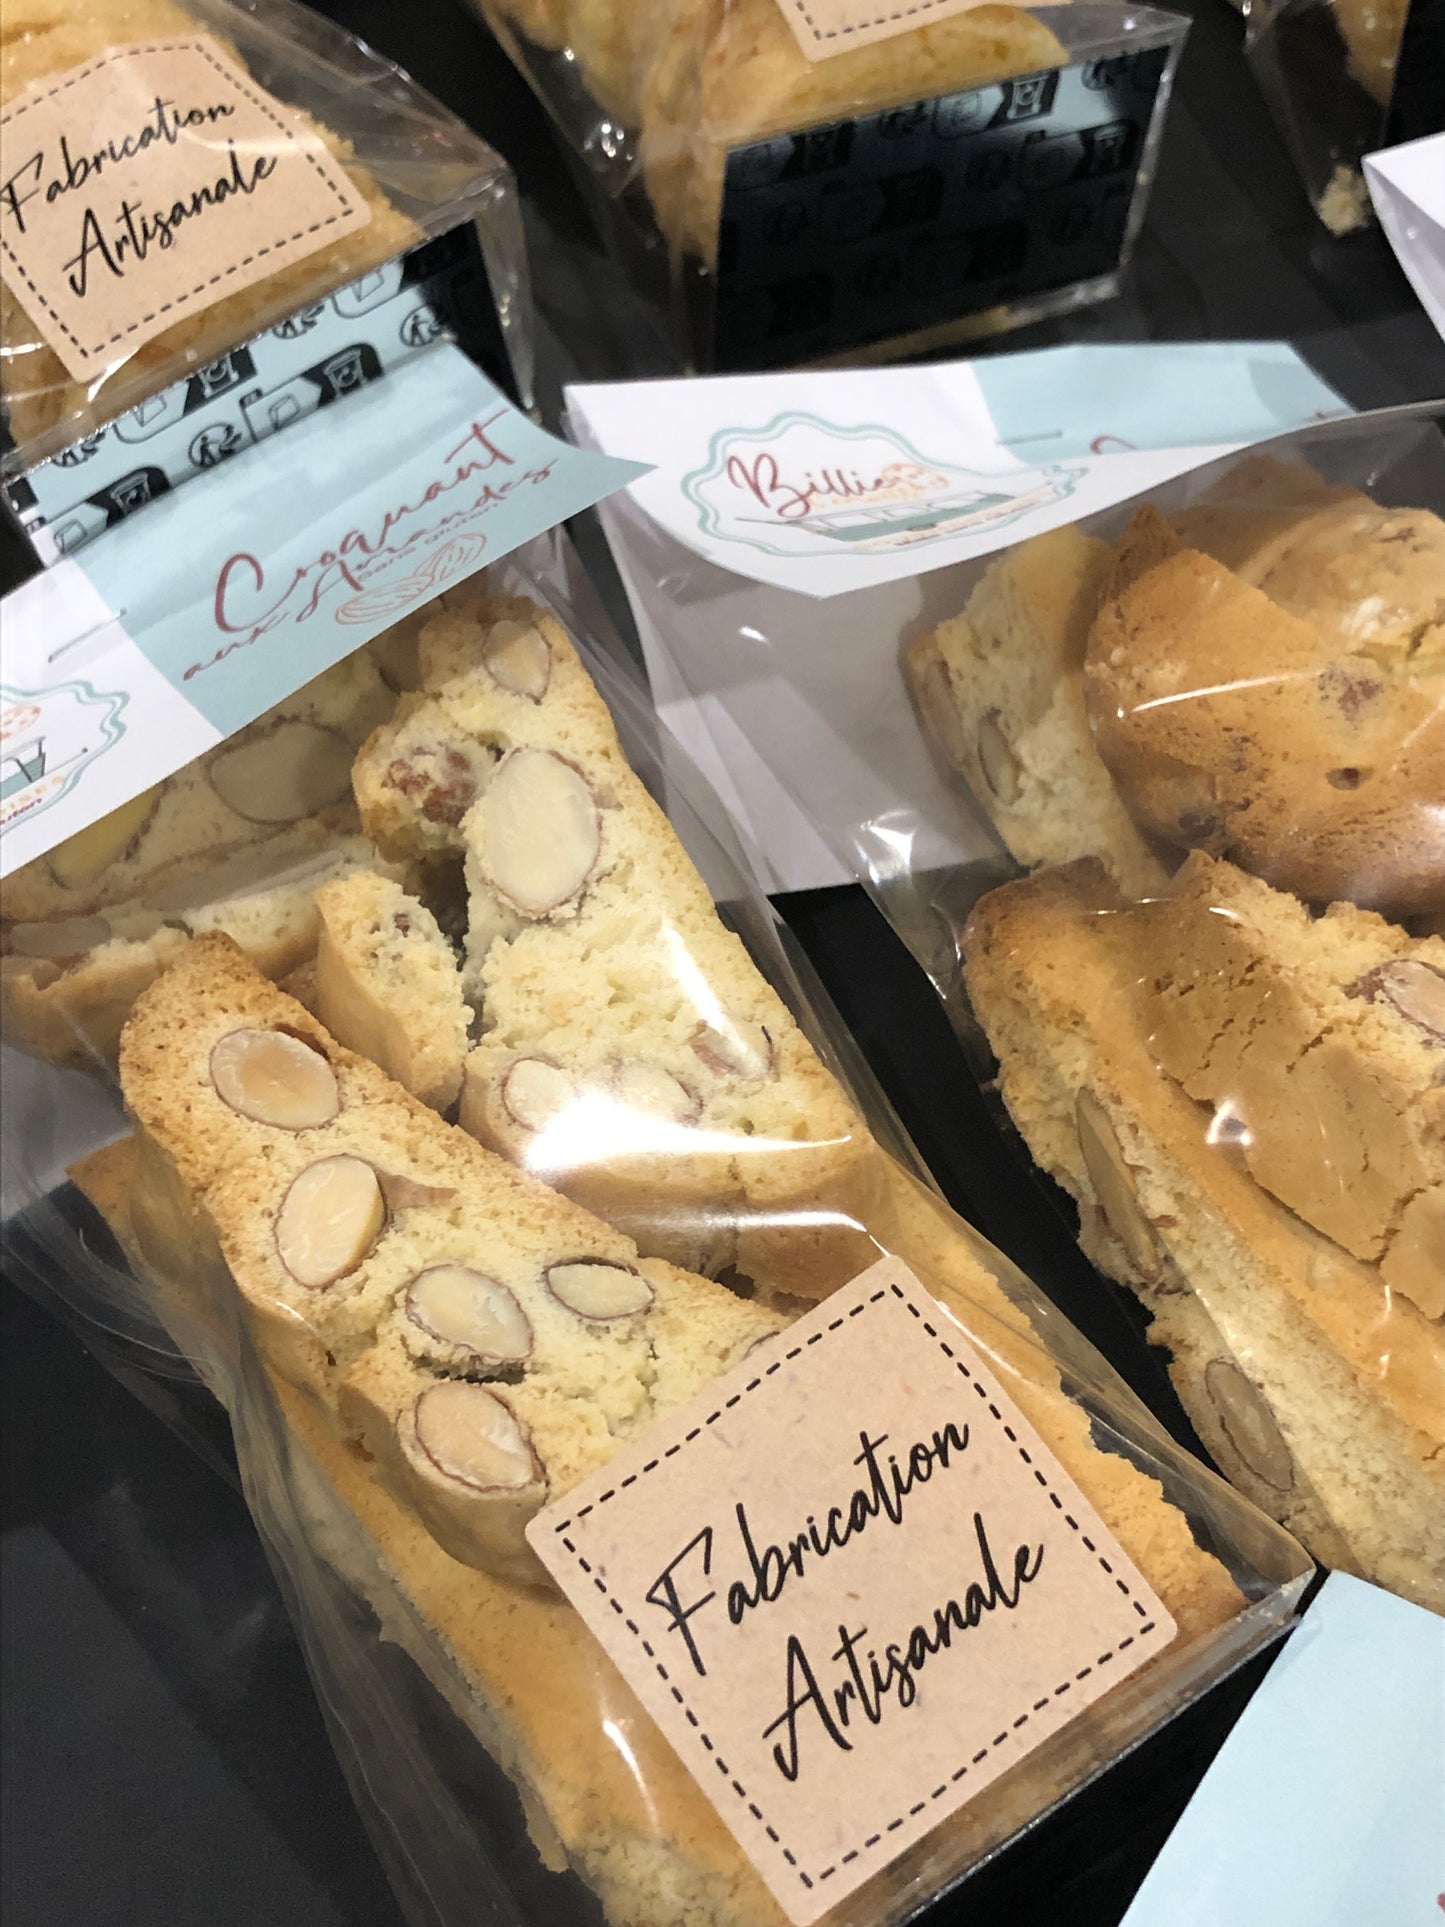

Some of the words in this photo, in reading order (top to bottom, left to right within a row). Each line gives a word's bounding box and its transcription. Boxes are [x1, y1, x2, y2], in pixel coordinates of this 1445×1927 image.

[0, 97, 235, 233] Fabrication
[62, 138, 278, 298] Artisanale
[214, 408, 514, 632] Croquant
[645, 1421, 971, 1676] Fabrication
[760, 1512, 1045, 1782] Artisanale
